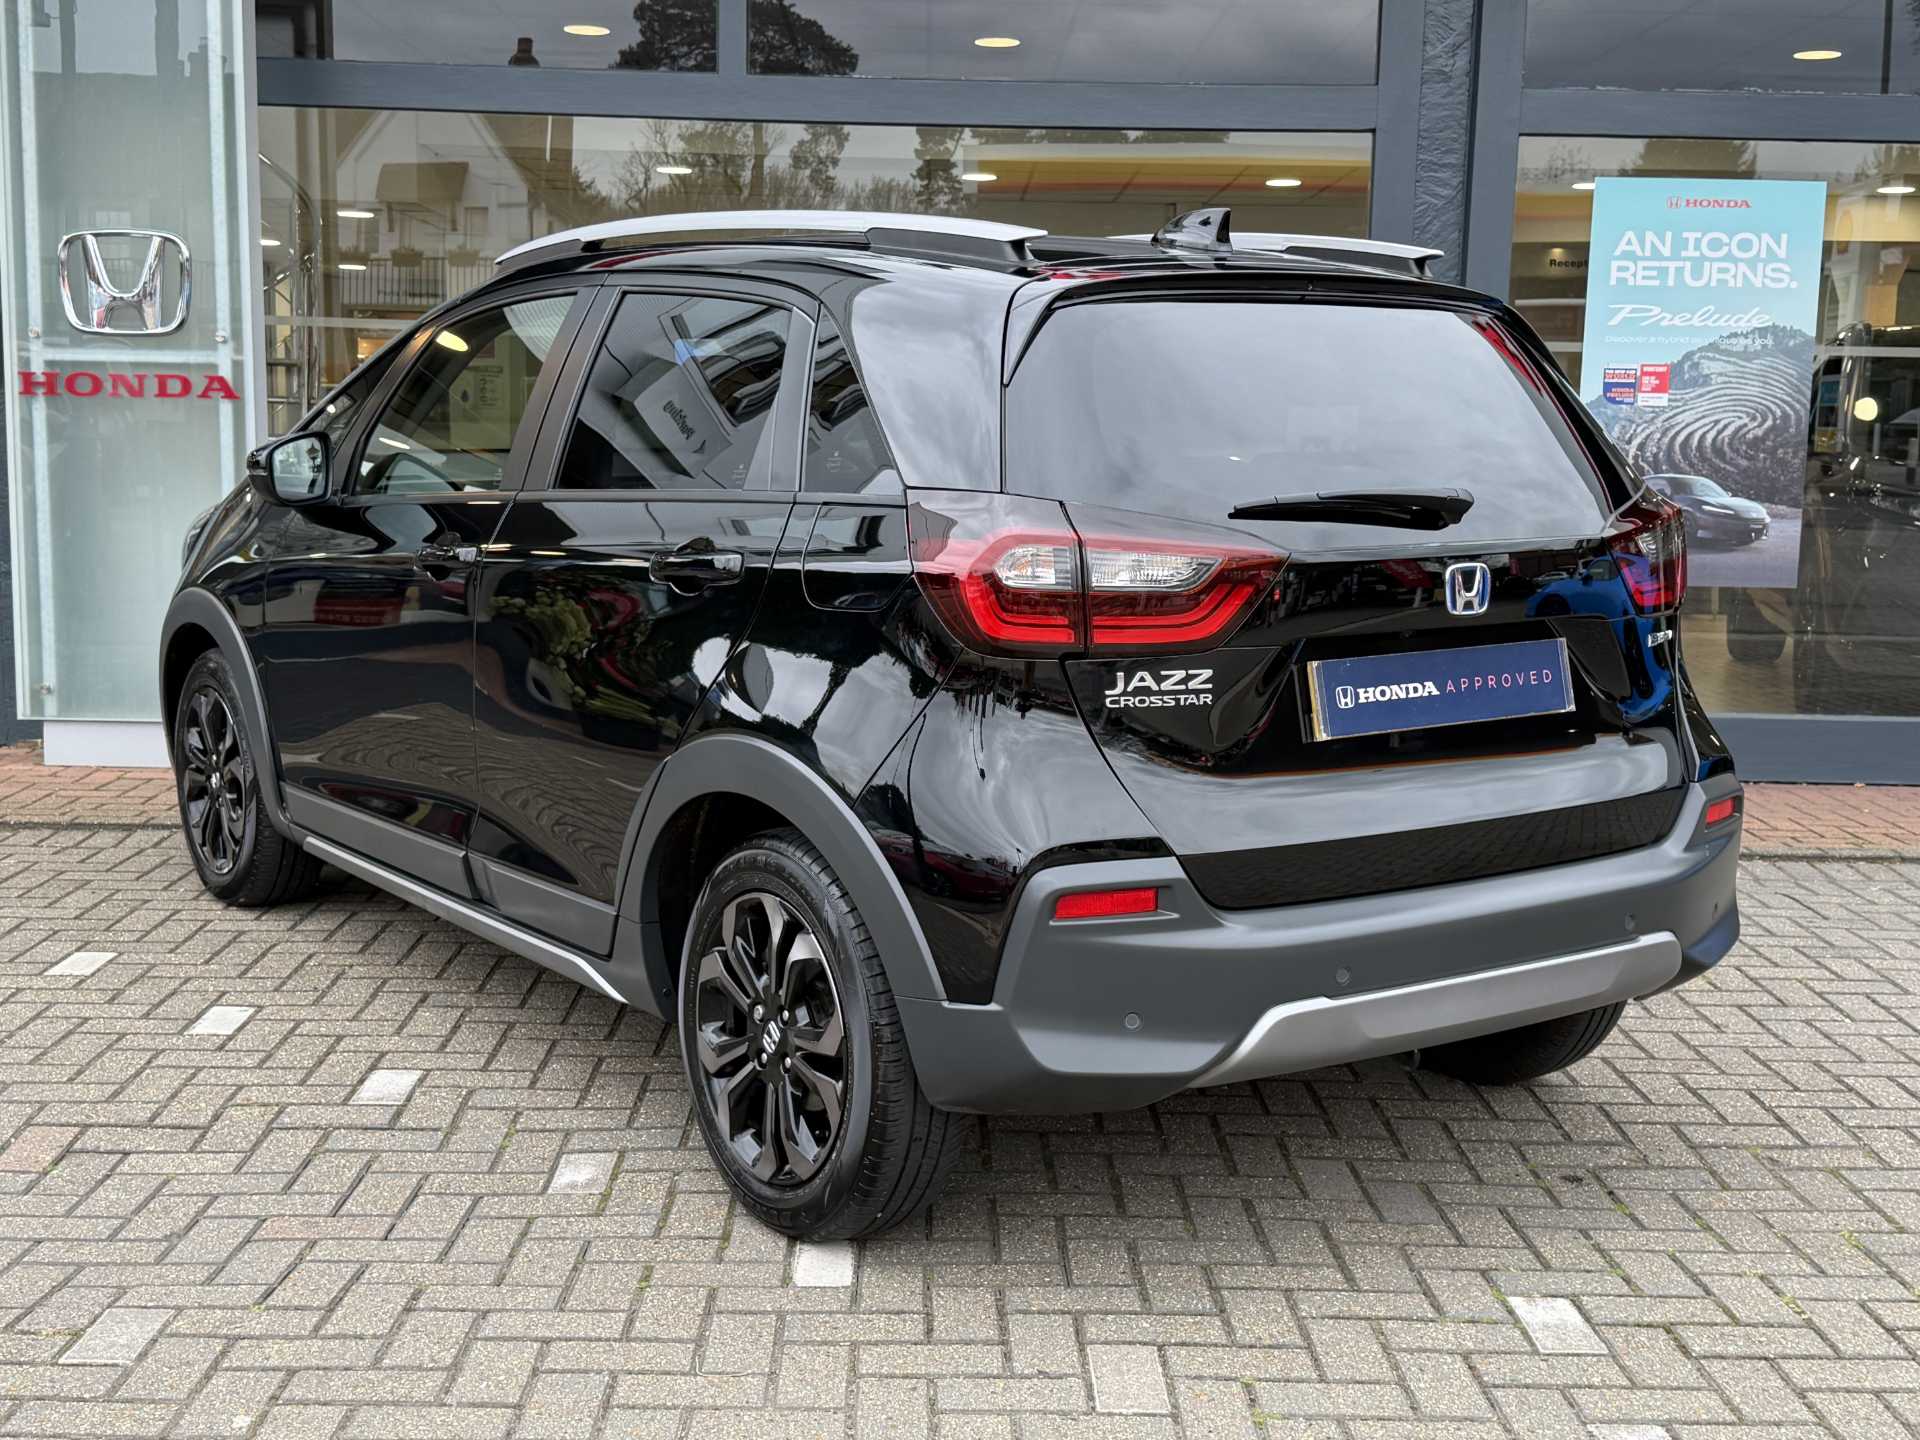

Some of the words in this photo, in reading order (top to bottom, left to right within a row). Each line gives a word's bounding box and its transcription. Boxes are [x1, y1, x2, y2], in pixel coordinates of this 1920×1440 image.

[1684, 198, 1752, 209] HONDA
[1613, 231, 1673, 259] AN
[1682, 232, 1789, 260] ICON
[1609, 260, 1797, 289] RETURNS.
[1607, 304, 1774, 329] Prelude
[18, 371, 240, 399] HONDA
[1104, 669, 1214, 695] JAZZ
[1357, 680, 1440, 704] HONDA
[1445, 669, 1553, 694] APPROVED
[1105, 694, 1212, 708] CROSSTAR
